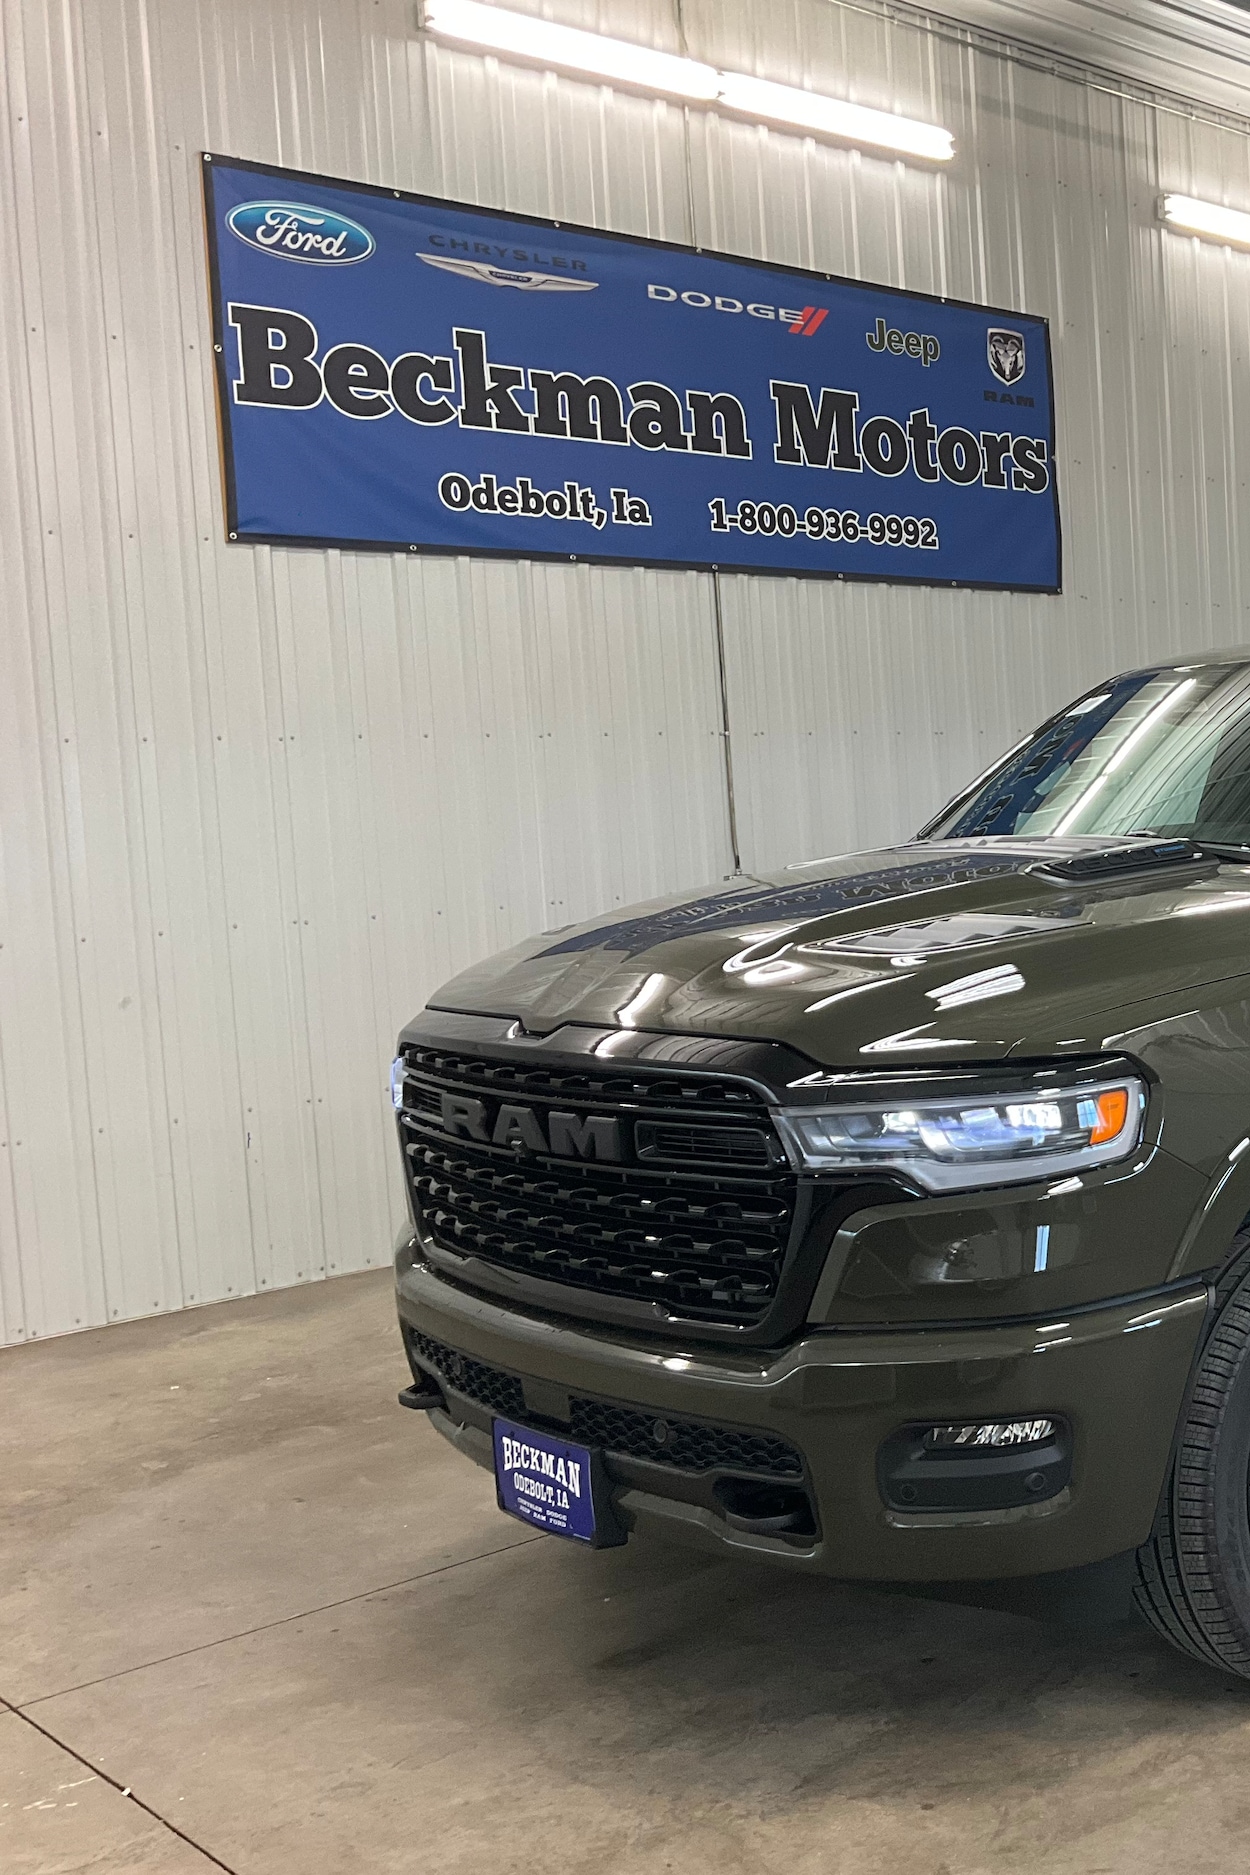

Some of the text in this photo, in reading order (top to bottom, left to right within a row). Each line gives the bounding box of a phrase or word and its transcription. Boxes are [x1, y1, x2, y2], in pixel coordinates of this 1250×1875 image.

[255, 208, 347, 258] Ford
[428, 234, 588, 272] CHRYSLER
[647, 284, 805, 326] DODGE
[866, 318, 940, 367] Jeep
[227, 302, 1050, 494] Beckman Motors
[984, 390, 1035, 408] RAM
[438, 472, 652, 530] Odebolt, Ia
[708, 497, 939, 550] 1-800-936-9992
[441, 1093, 622, 1162] RAM
[502, 1436, 581, 1498] BECKMAN
[513, 1471, 570, 1510] ODEBOLT, IA
[533, 1511, 547, 1522] RAM
[549, 1517, 567, 1528] FORD
